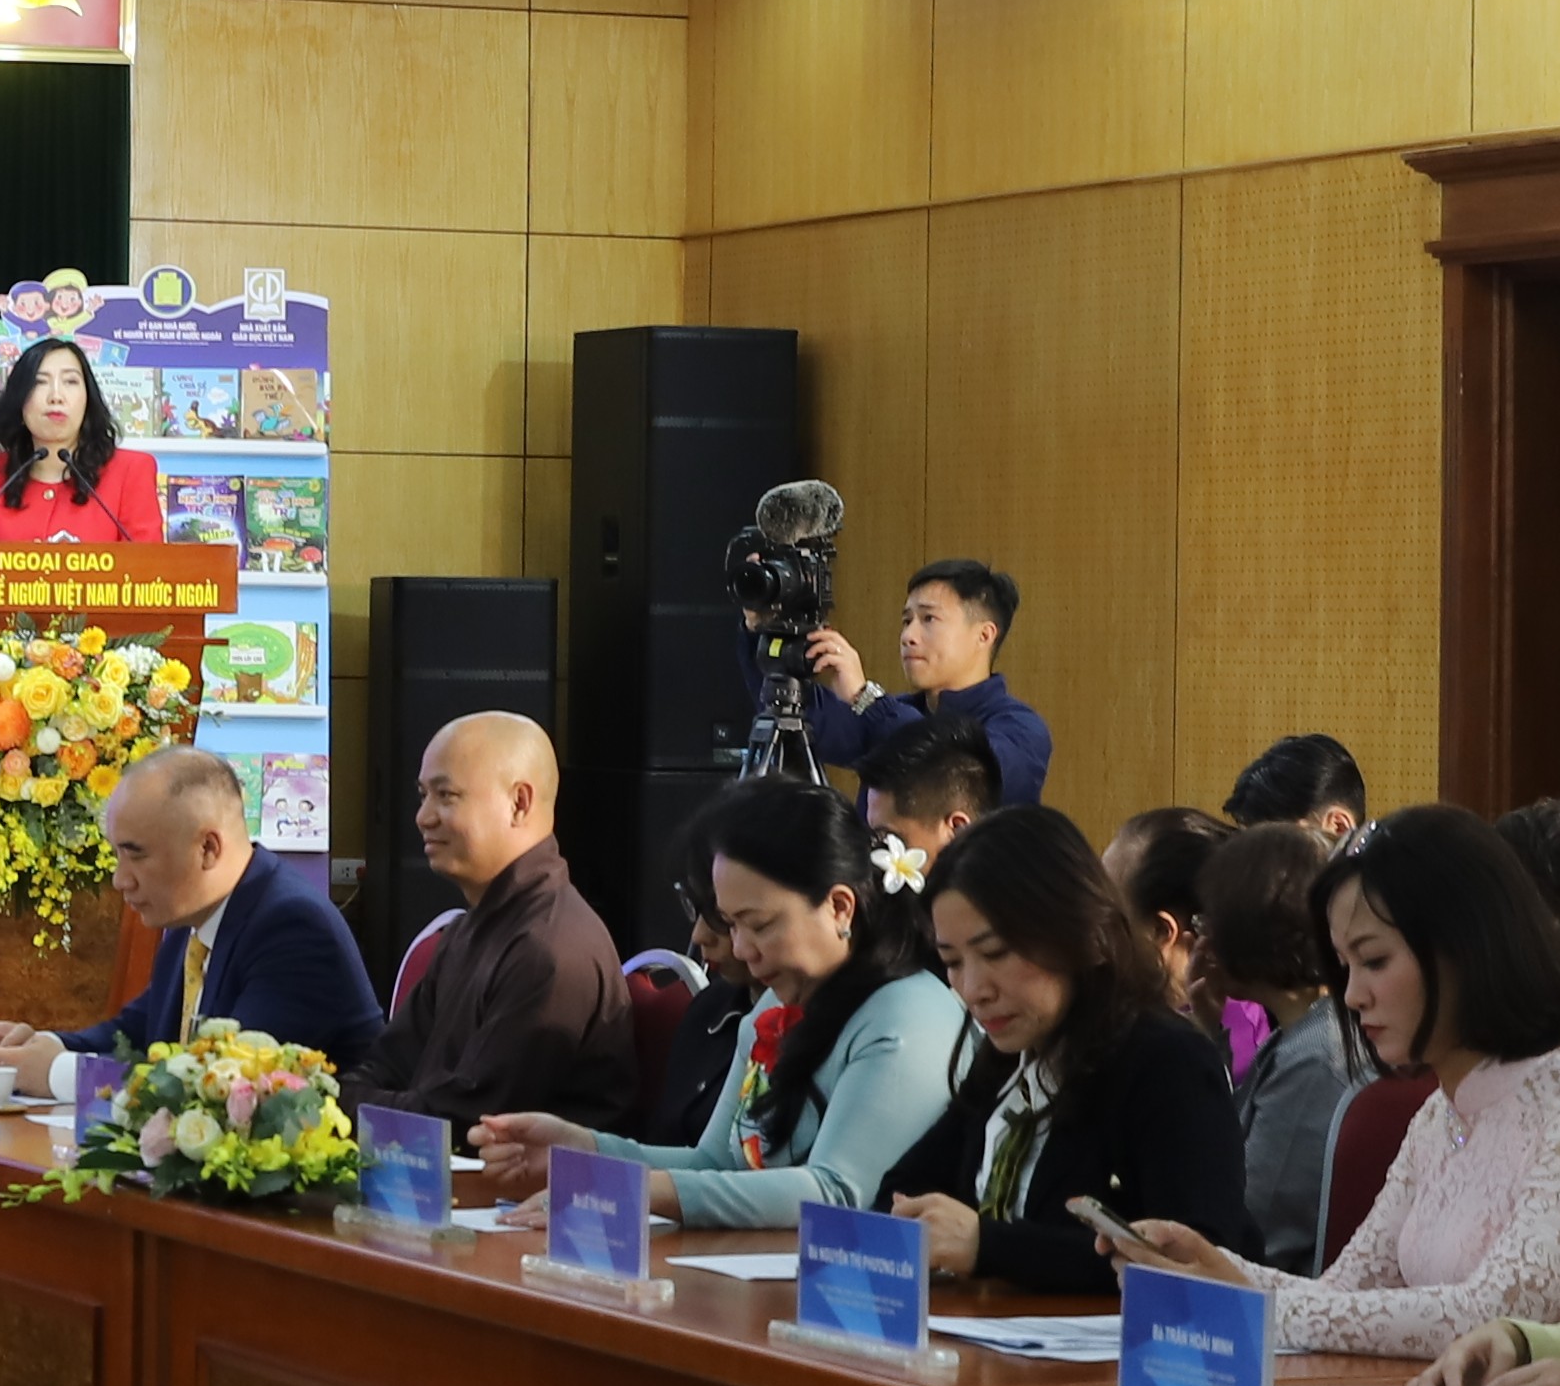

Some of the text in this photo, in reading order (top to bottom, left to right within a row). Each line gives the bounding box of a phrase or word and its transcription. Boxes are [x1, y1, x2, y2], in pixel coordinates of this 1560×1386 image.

[65, 552, 115, 572] GIAO
[8, 576, 51, 606] NGƯỜI
[54, 577, 83, 611] VIỆT
[86, 582, 119, 607] NAM
[122, 573, 131, 607] Ở
[135, 576, 172, 607] NƯỚC
[176, 578, 219, 607] NGOÀI
